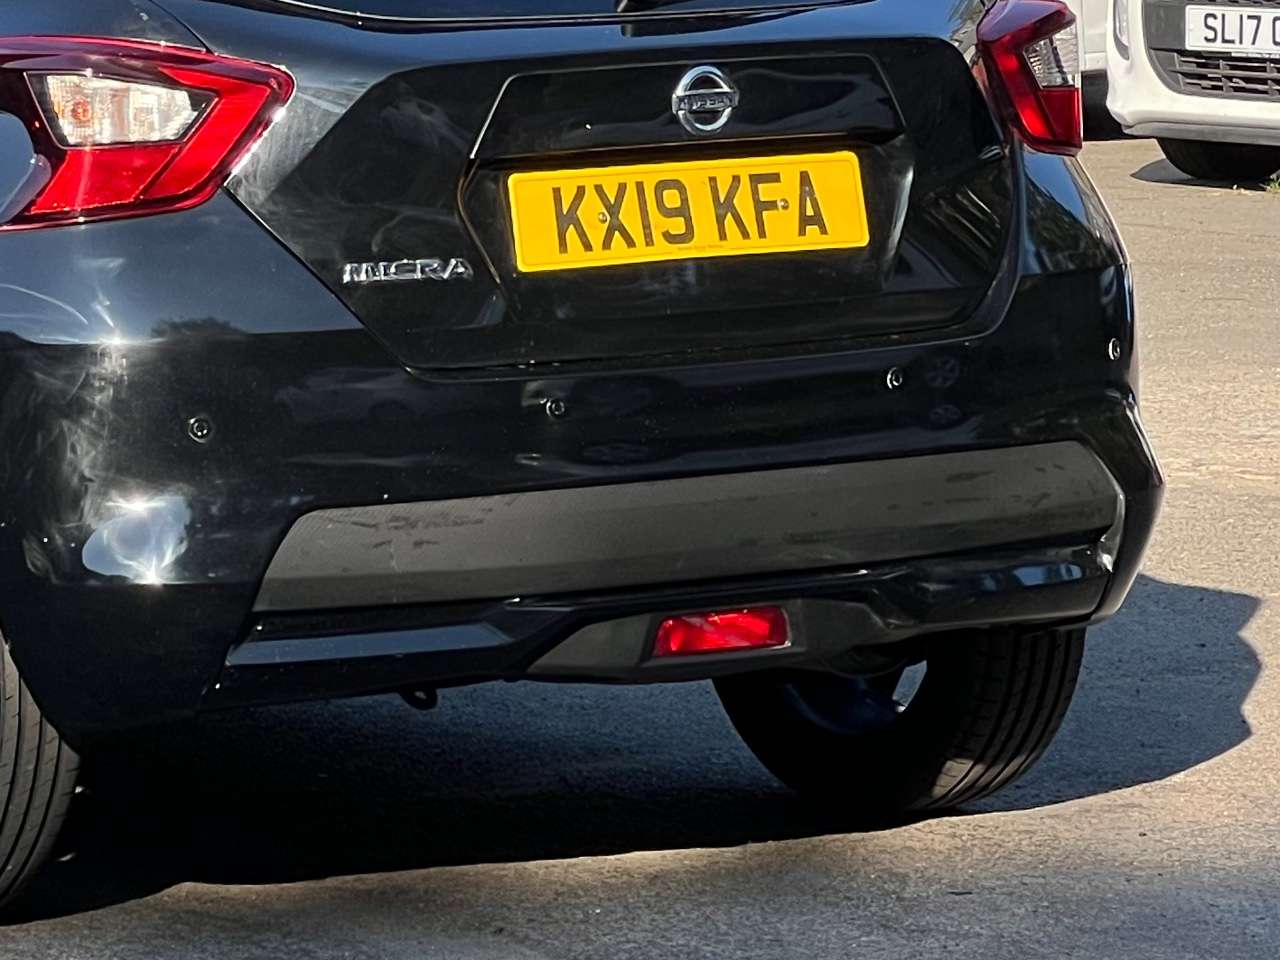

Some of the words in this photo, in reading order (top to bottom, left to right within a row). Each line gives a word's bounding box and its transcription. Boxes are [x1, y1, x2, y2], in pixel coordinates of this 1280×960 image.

[1203, 13, 1262, 46] SL17
[551, 178, 696, 255] KX19
[708, 169, 829, 242] KFA
[342, 257, 474, 284] MICRA
